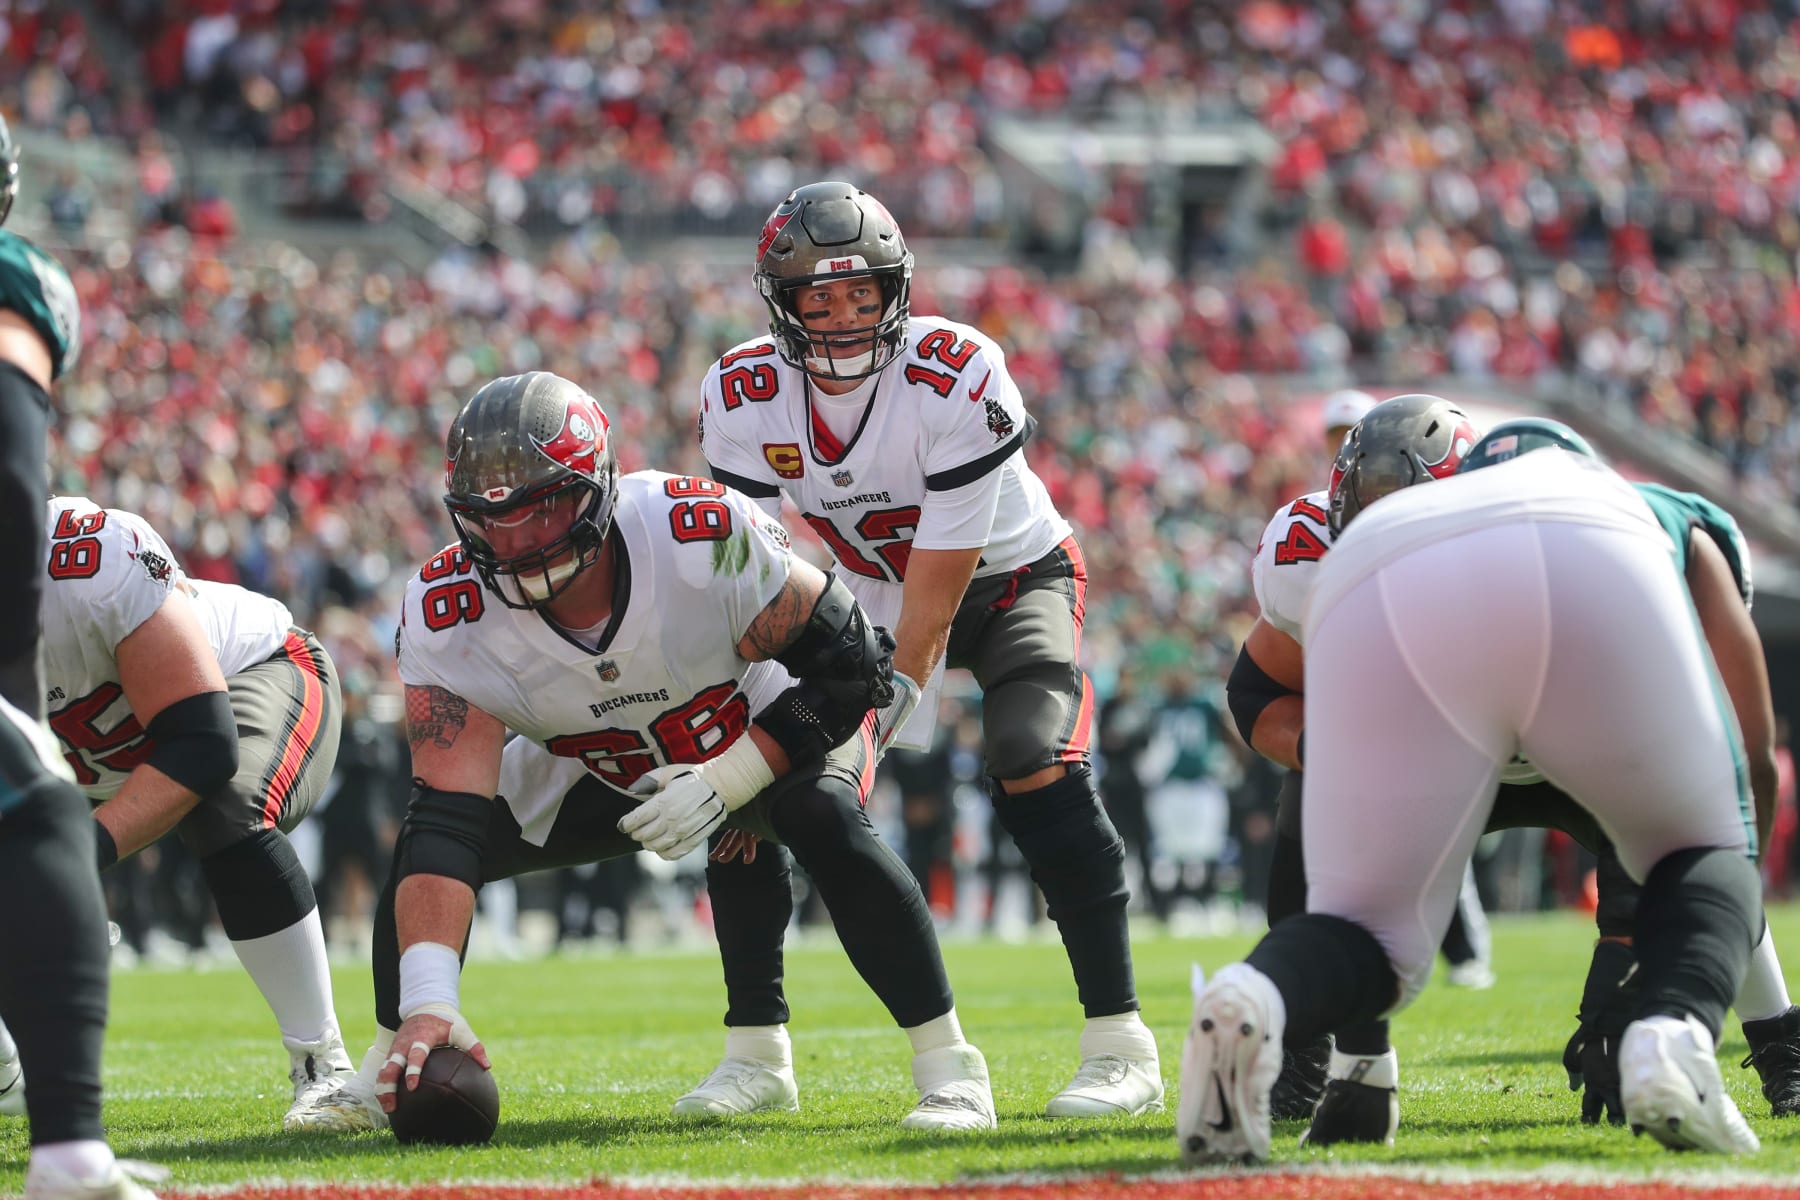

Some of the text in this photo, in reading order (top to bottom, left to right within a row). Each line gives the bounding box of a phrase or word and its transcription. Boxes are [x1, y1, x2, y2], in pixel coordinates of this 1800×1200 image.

[719, 343, 779, 412] 12
[904, 328, 981, 399] 12
[766, 446, 800, 470] C
[664, 476, 733, 544] 66
[801, 505, 921, 583] 12
[48, 510, 107, 581] 65
[420, 545, 485, 632] 66
[588, 688, 670, 718] BUCCANEERS
